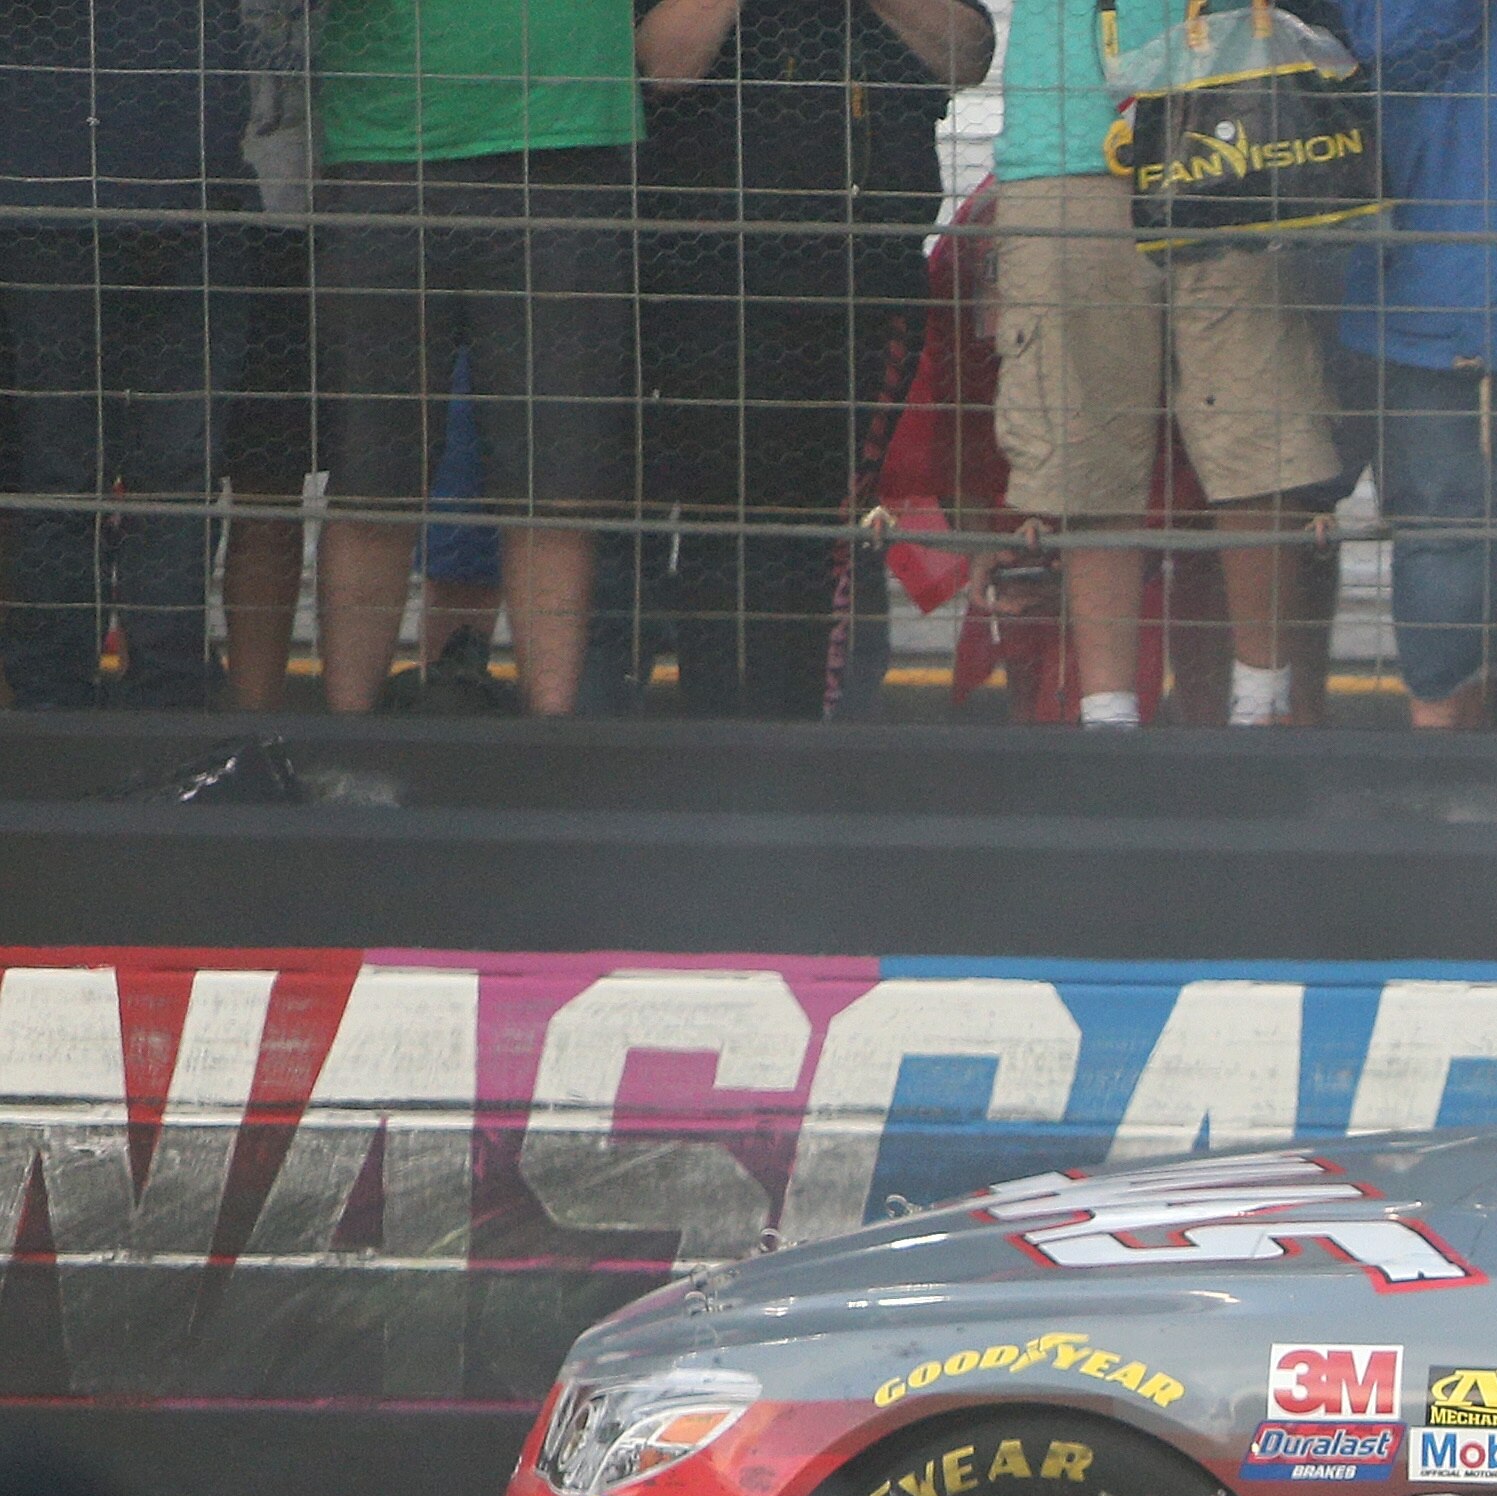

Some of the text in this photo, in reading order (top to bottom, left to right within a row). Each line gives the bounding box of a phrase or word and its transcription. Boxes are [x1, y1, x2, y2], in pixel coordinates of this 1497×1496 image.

[1273, 1349, 1398, 1415] 3M
[1257, 1429, 1392, 1460] Duralast
[1290, 1464, 1358, 1480] BRAKES
